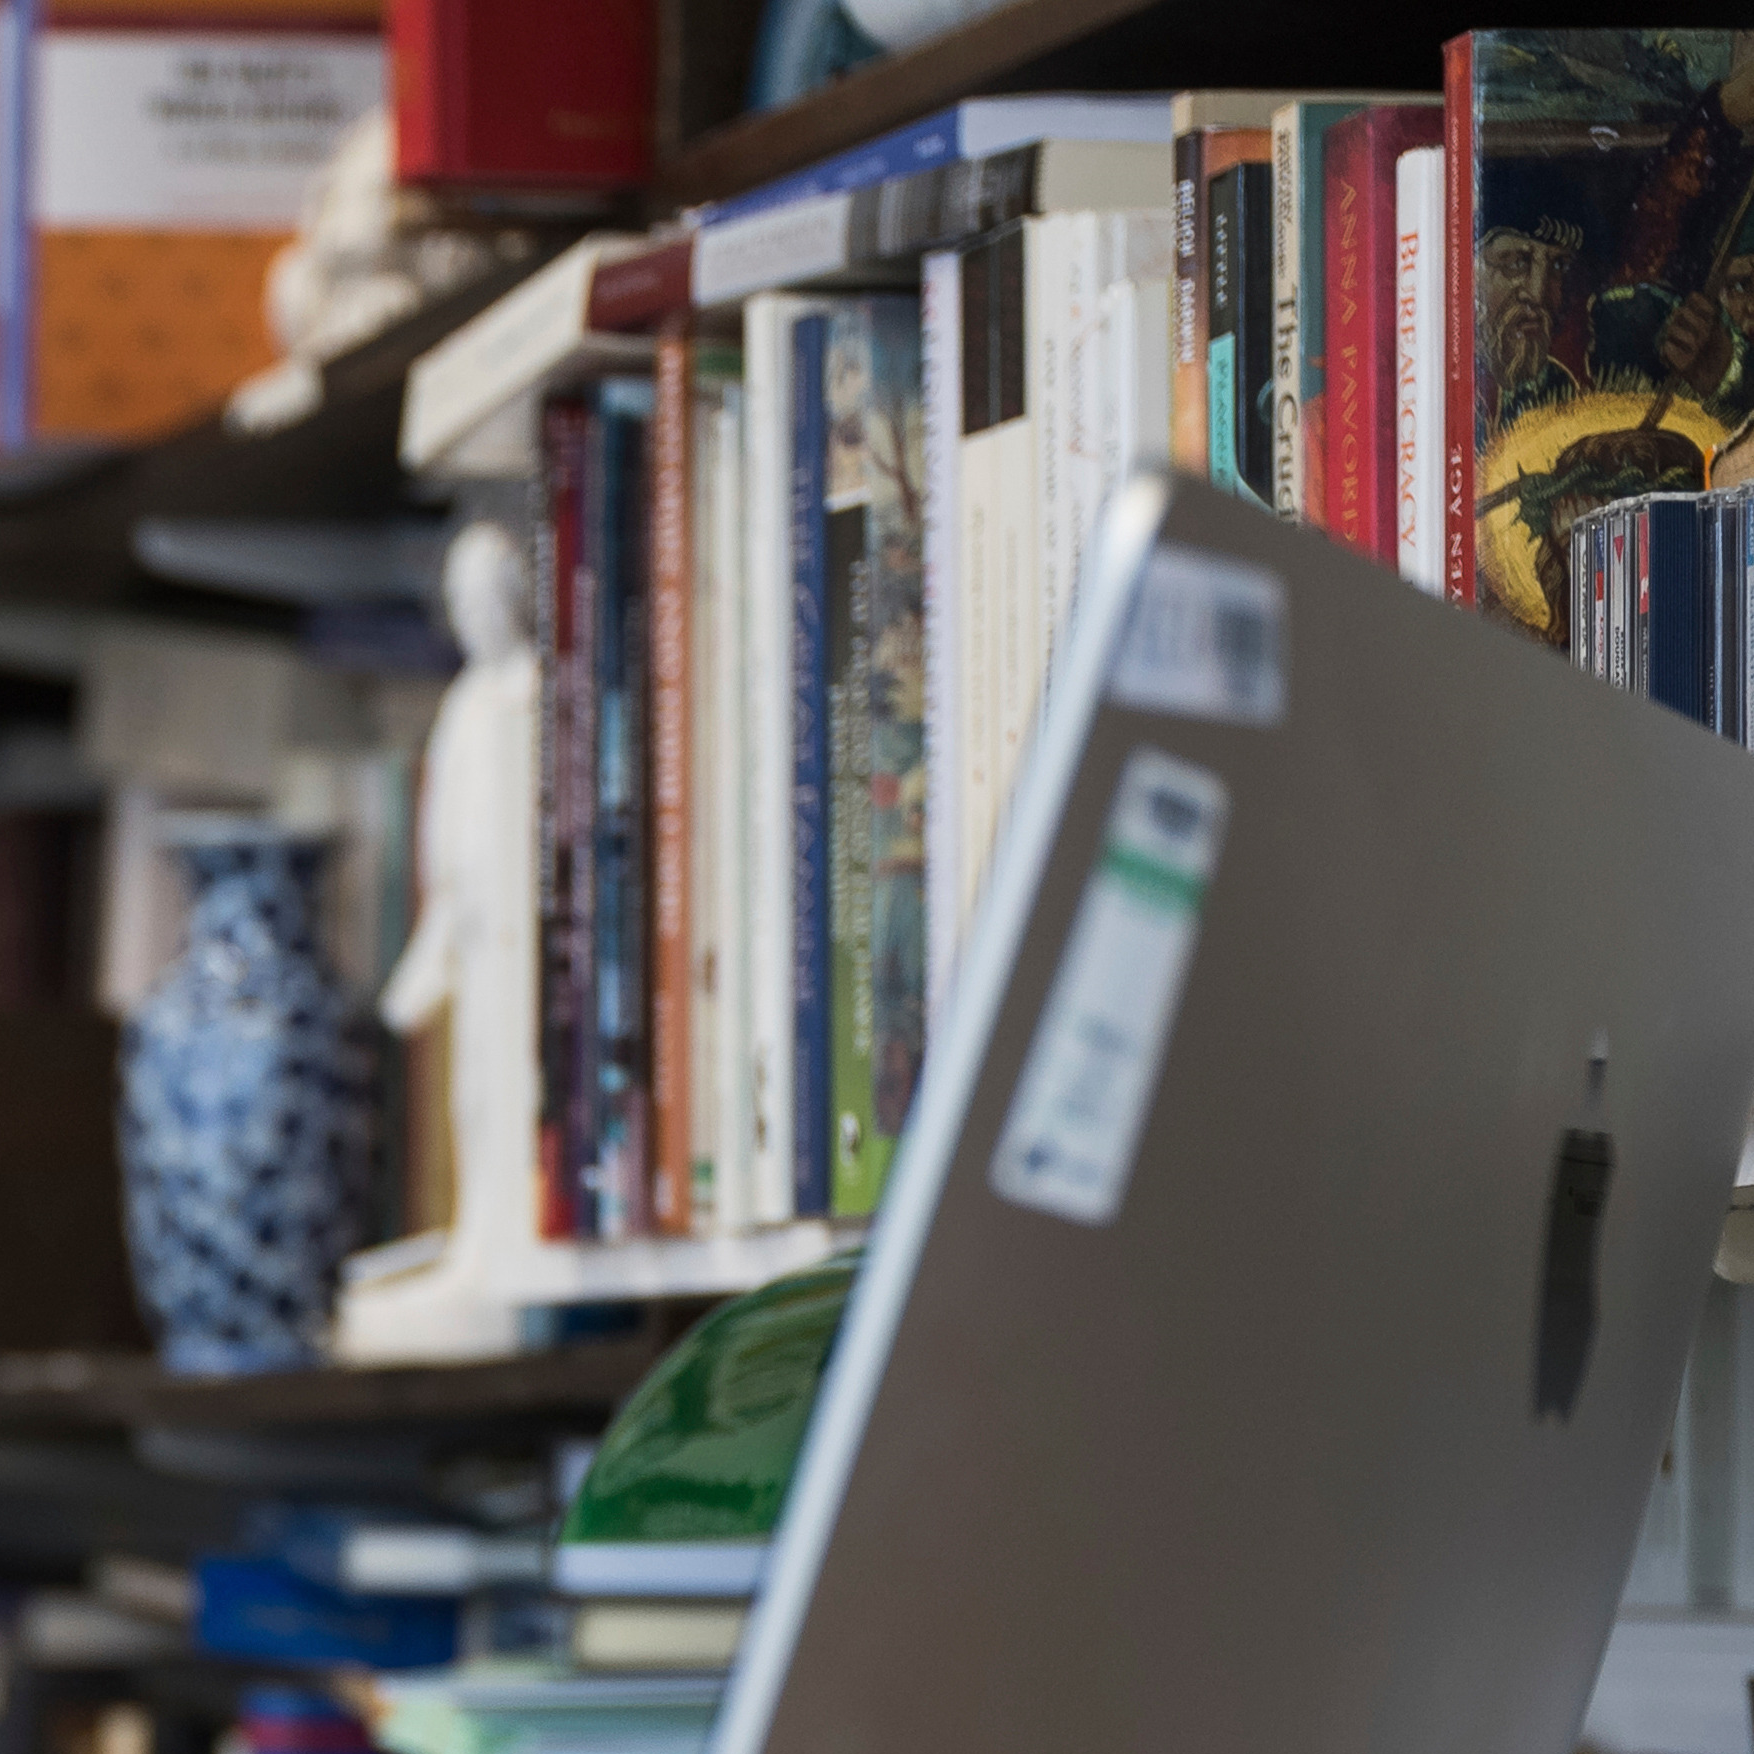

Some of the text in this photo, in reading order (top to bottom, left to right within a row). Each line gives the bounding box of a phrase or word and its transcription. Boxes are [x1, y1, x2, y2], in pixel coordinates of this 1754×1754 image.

[1278, 284, 1298, 377] The
[1340, 179, 1359, 542] ANNA PAVORD
[1400, 231, 1419, 547] BUREAUCRACY
[1278, 394, 1299, 524] Cruci
[1449, 532, 1463, 609] YEN
